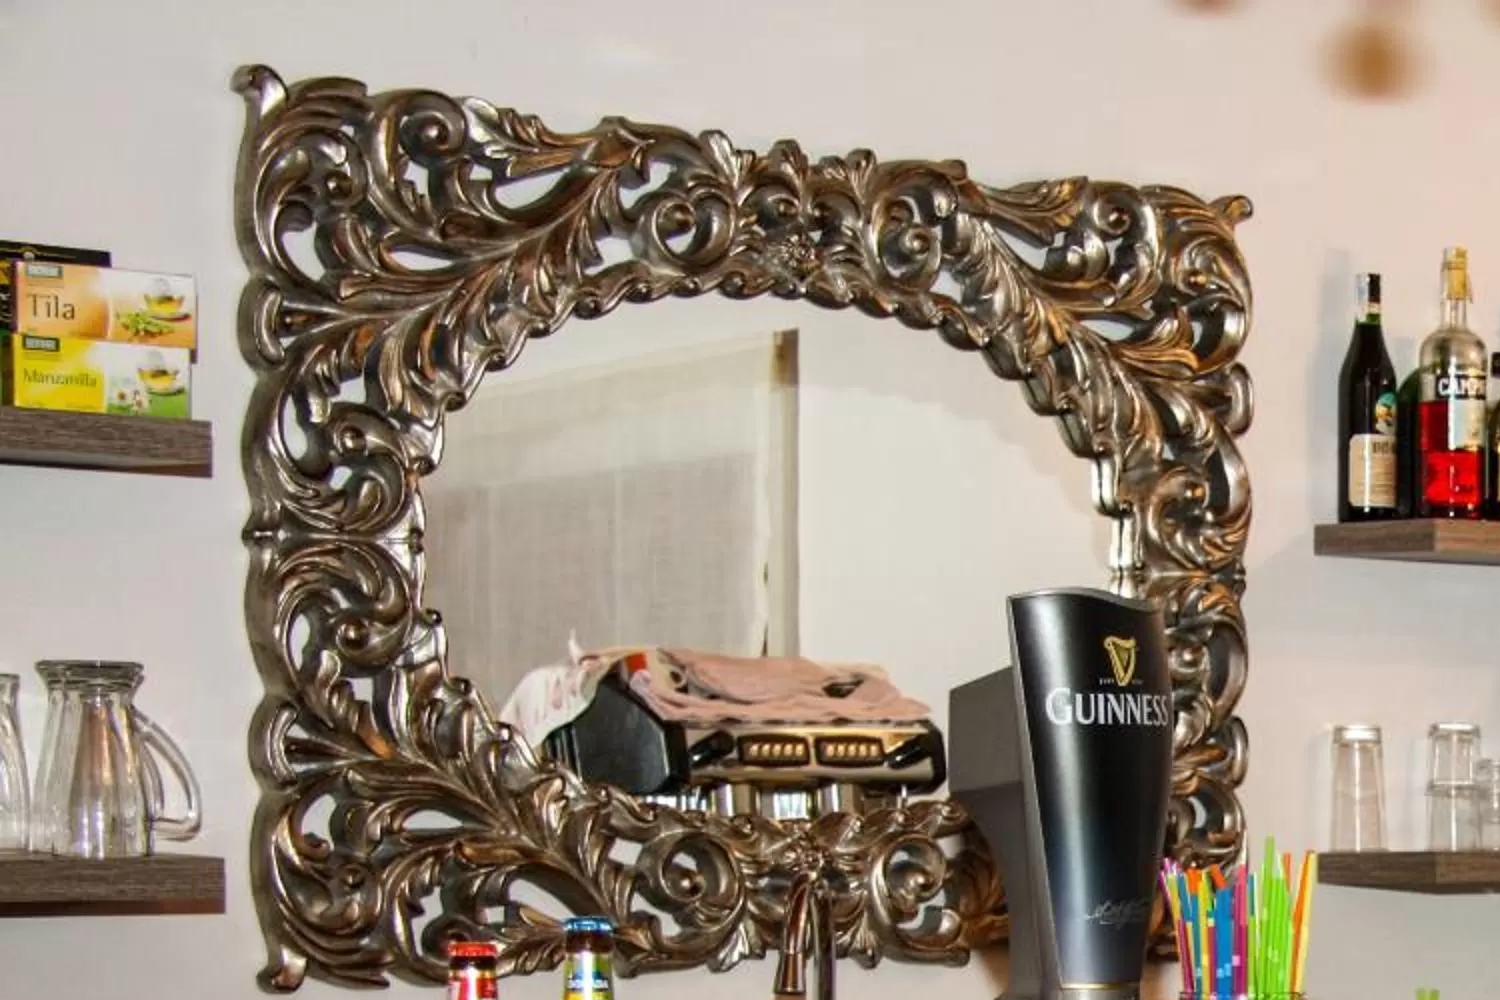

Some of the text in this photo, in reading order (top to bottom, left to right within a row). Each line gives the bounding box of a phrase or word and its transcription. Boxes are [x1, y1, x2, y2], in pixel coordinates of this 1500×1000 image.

[27, 293, 75, 320] Tila
[23, 367, 97, 389] Manzanilla
[1045, 687, 1170, 726] GUINNESS
